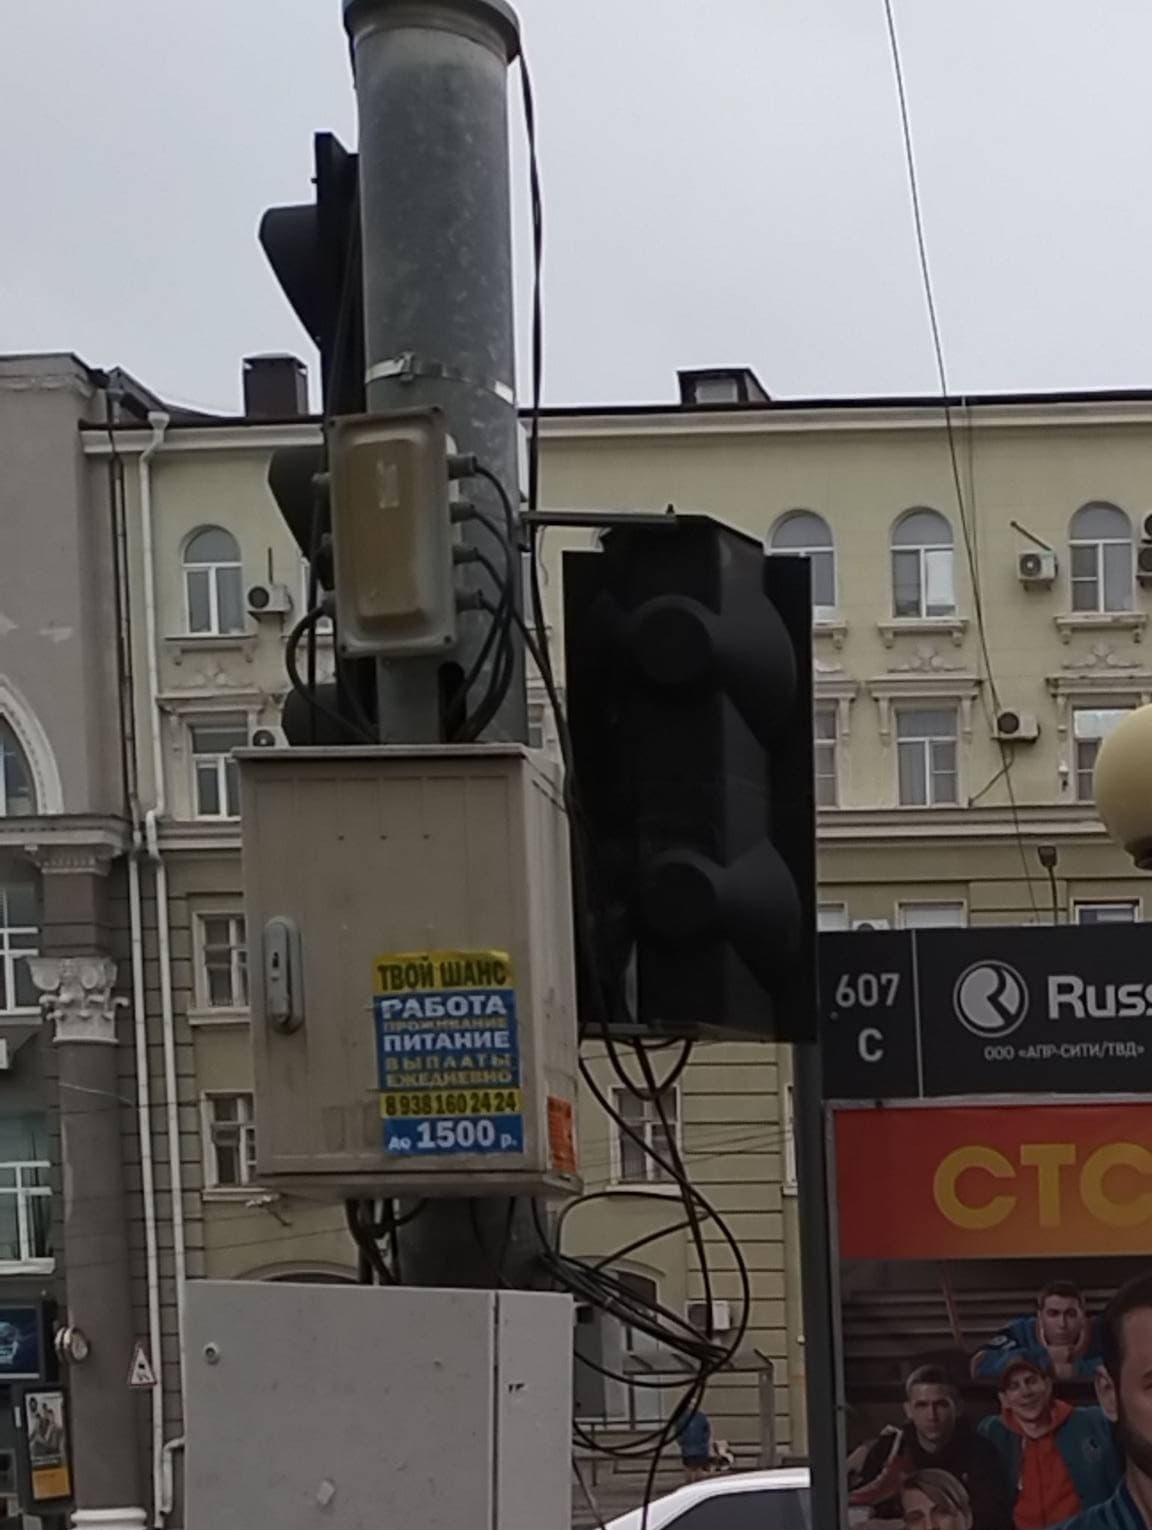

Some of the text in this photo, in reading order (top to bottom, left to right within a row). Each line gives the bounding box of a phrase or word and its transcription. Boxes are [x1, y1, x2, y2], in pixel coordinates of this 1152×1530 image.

[377, 955, 507, 990] ТВОЙ ШАНС
[835, 972, 900, 1008] 607
[381, 995, 507, 1019] РАБОТА
[384, 1031, 510, 1052] ПИТАНИЕ
[984, 1045, 1015, 1060] ООО
[386, 1053, 512, 1071] ВЫПЛАТЫ
[416, 1119, 496, 1149] 1500
